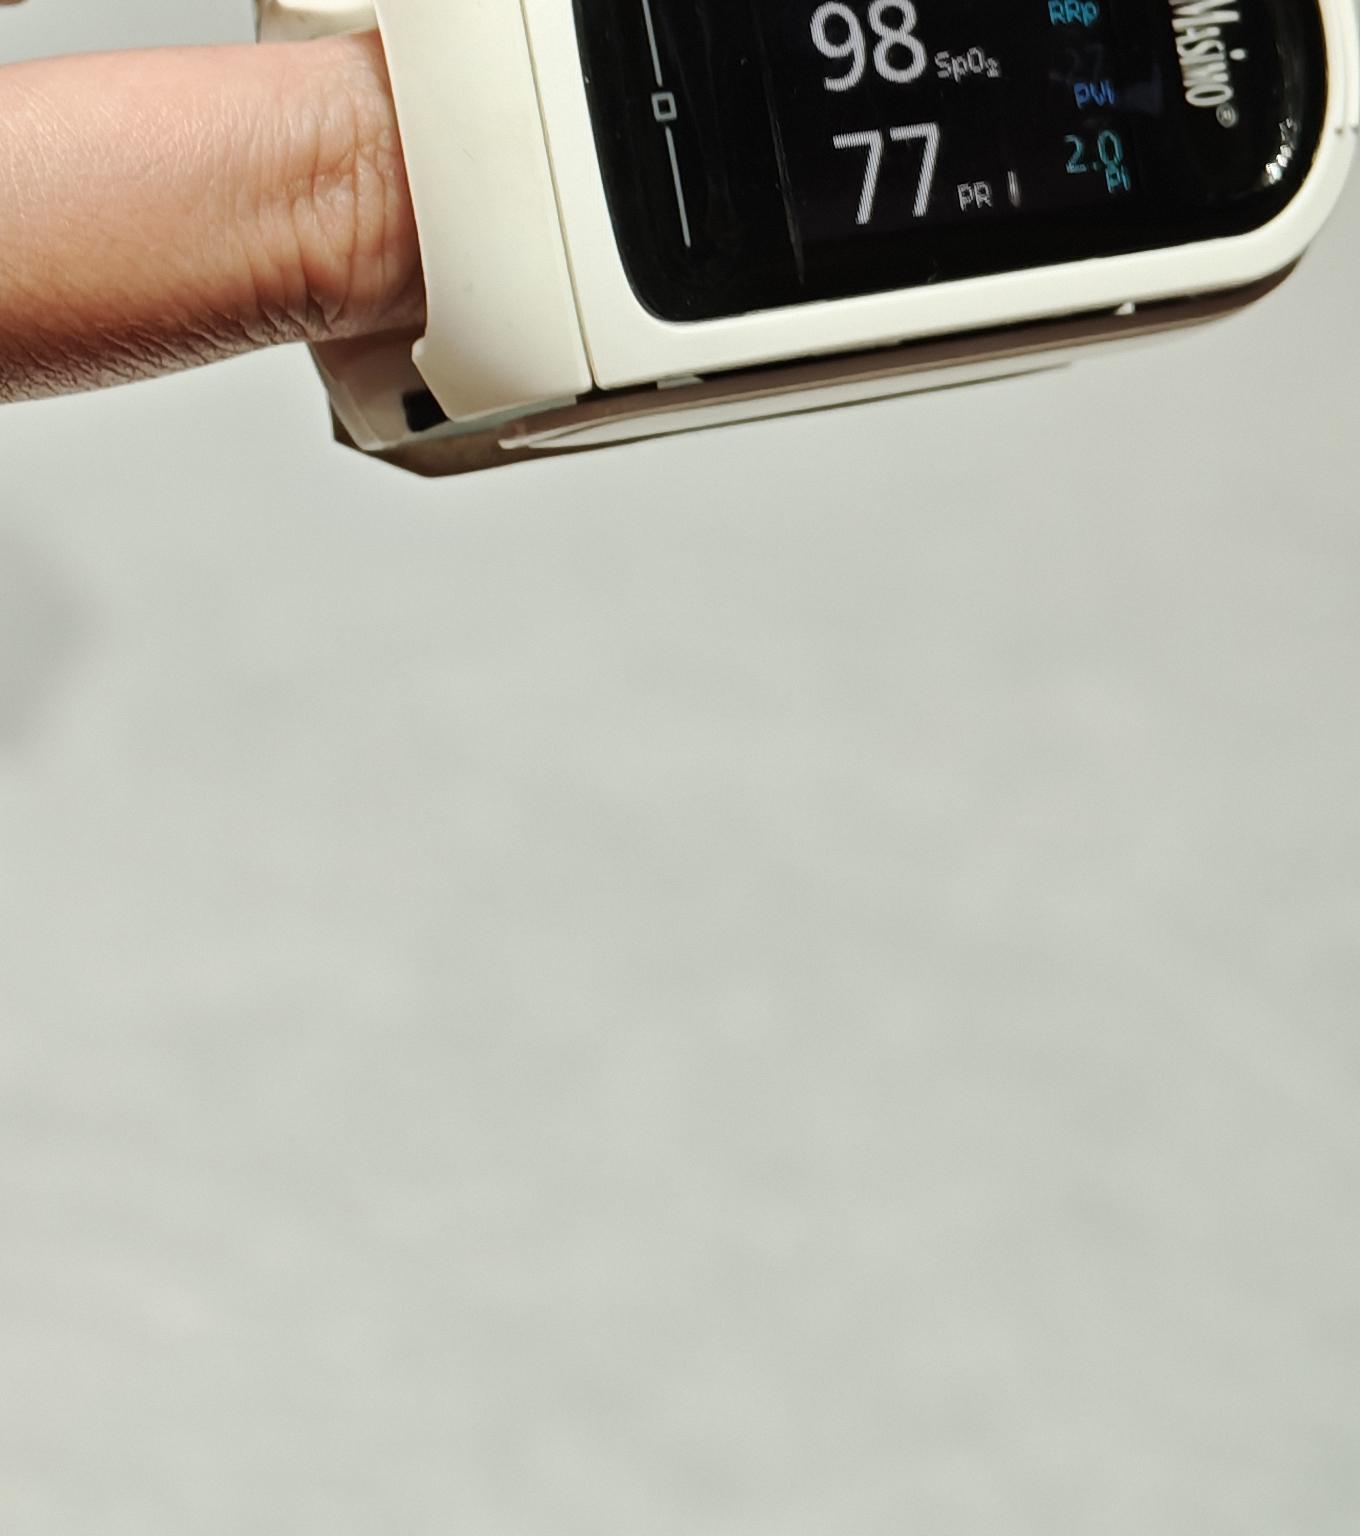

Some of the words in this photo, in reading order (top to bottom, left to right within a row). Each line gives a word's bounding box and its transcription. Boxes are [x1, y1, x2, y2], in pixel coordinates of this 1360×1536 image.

[832, 122, 940, 225] 77
[957, 180, 993, 211] PR
[1065, 130, 1124, 174] 2.0
